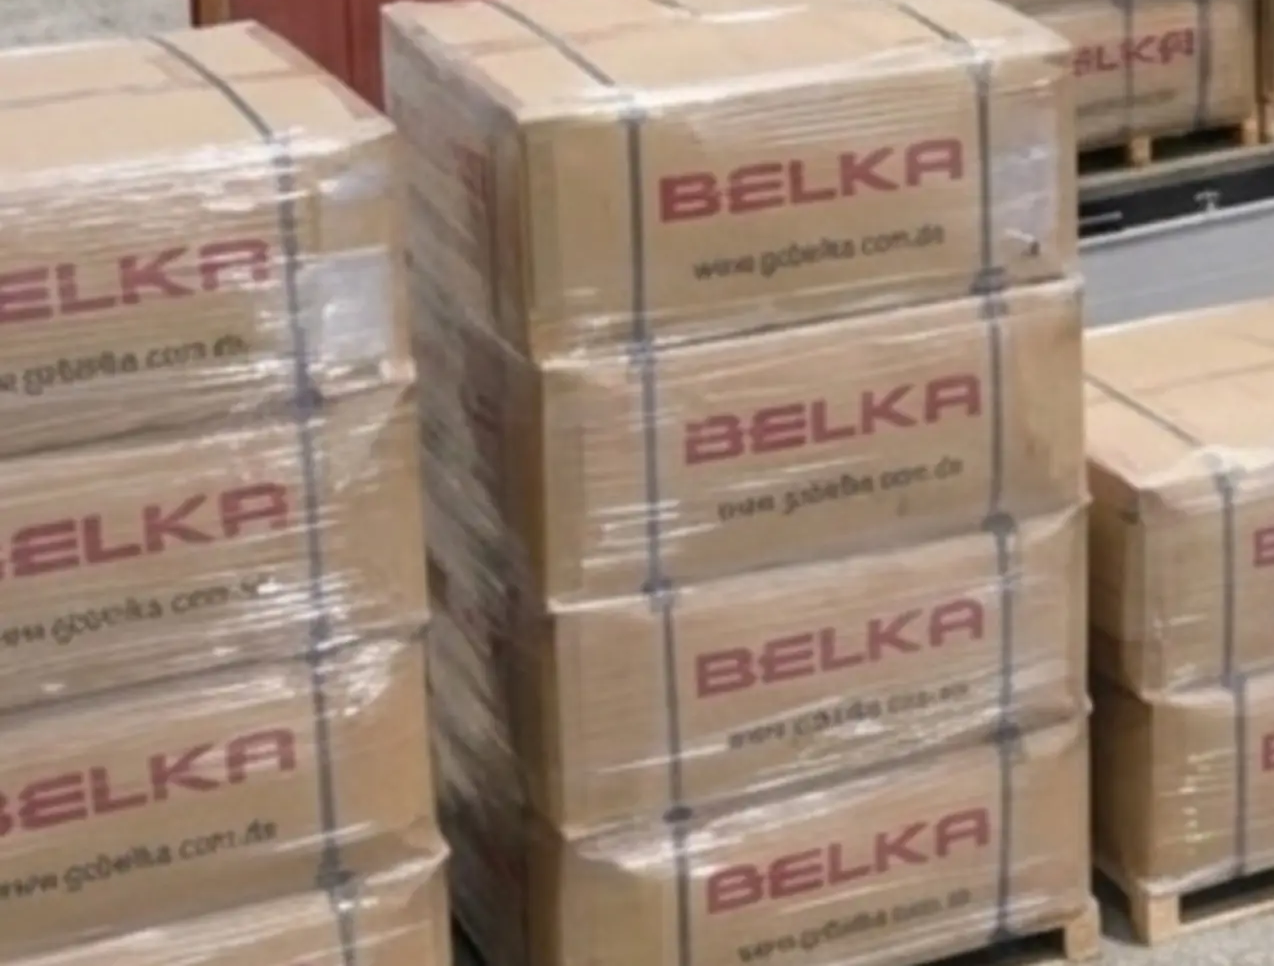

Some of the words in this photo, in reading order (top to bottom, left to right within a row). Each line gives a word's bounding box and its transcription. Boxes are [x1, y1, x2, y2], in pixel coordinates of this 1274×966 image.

[659, 139, 963, 223] BELKA
[685, 374, 982, 465] BELKA
[0, 483, 288, 579] ELKA
[696, 598, 984, 699] BELKA
[0, 728, 296, 833] ELKA
[707, 808, 991, 914] BELKA
